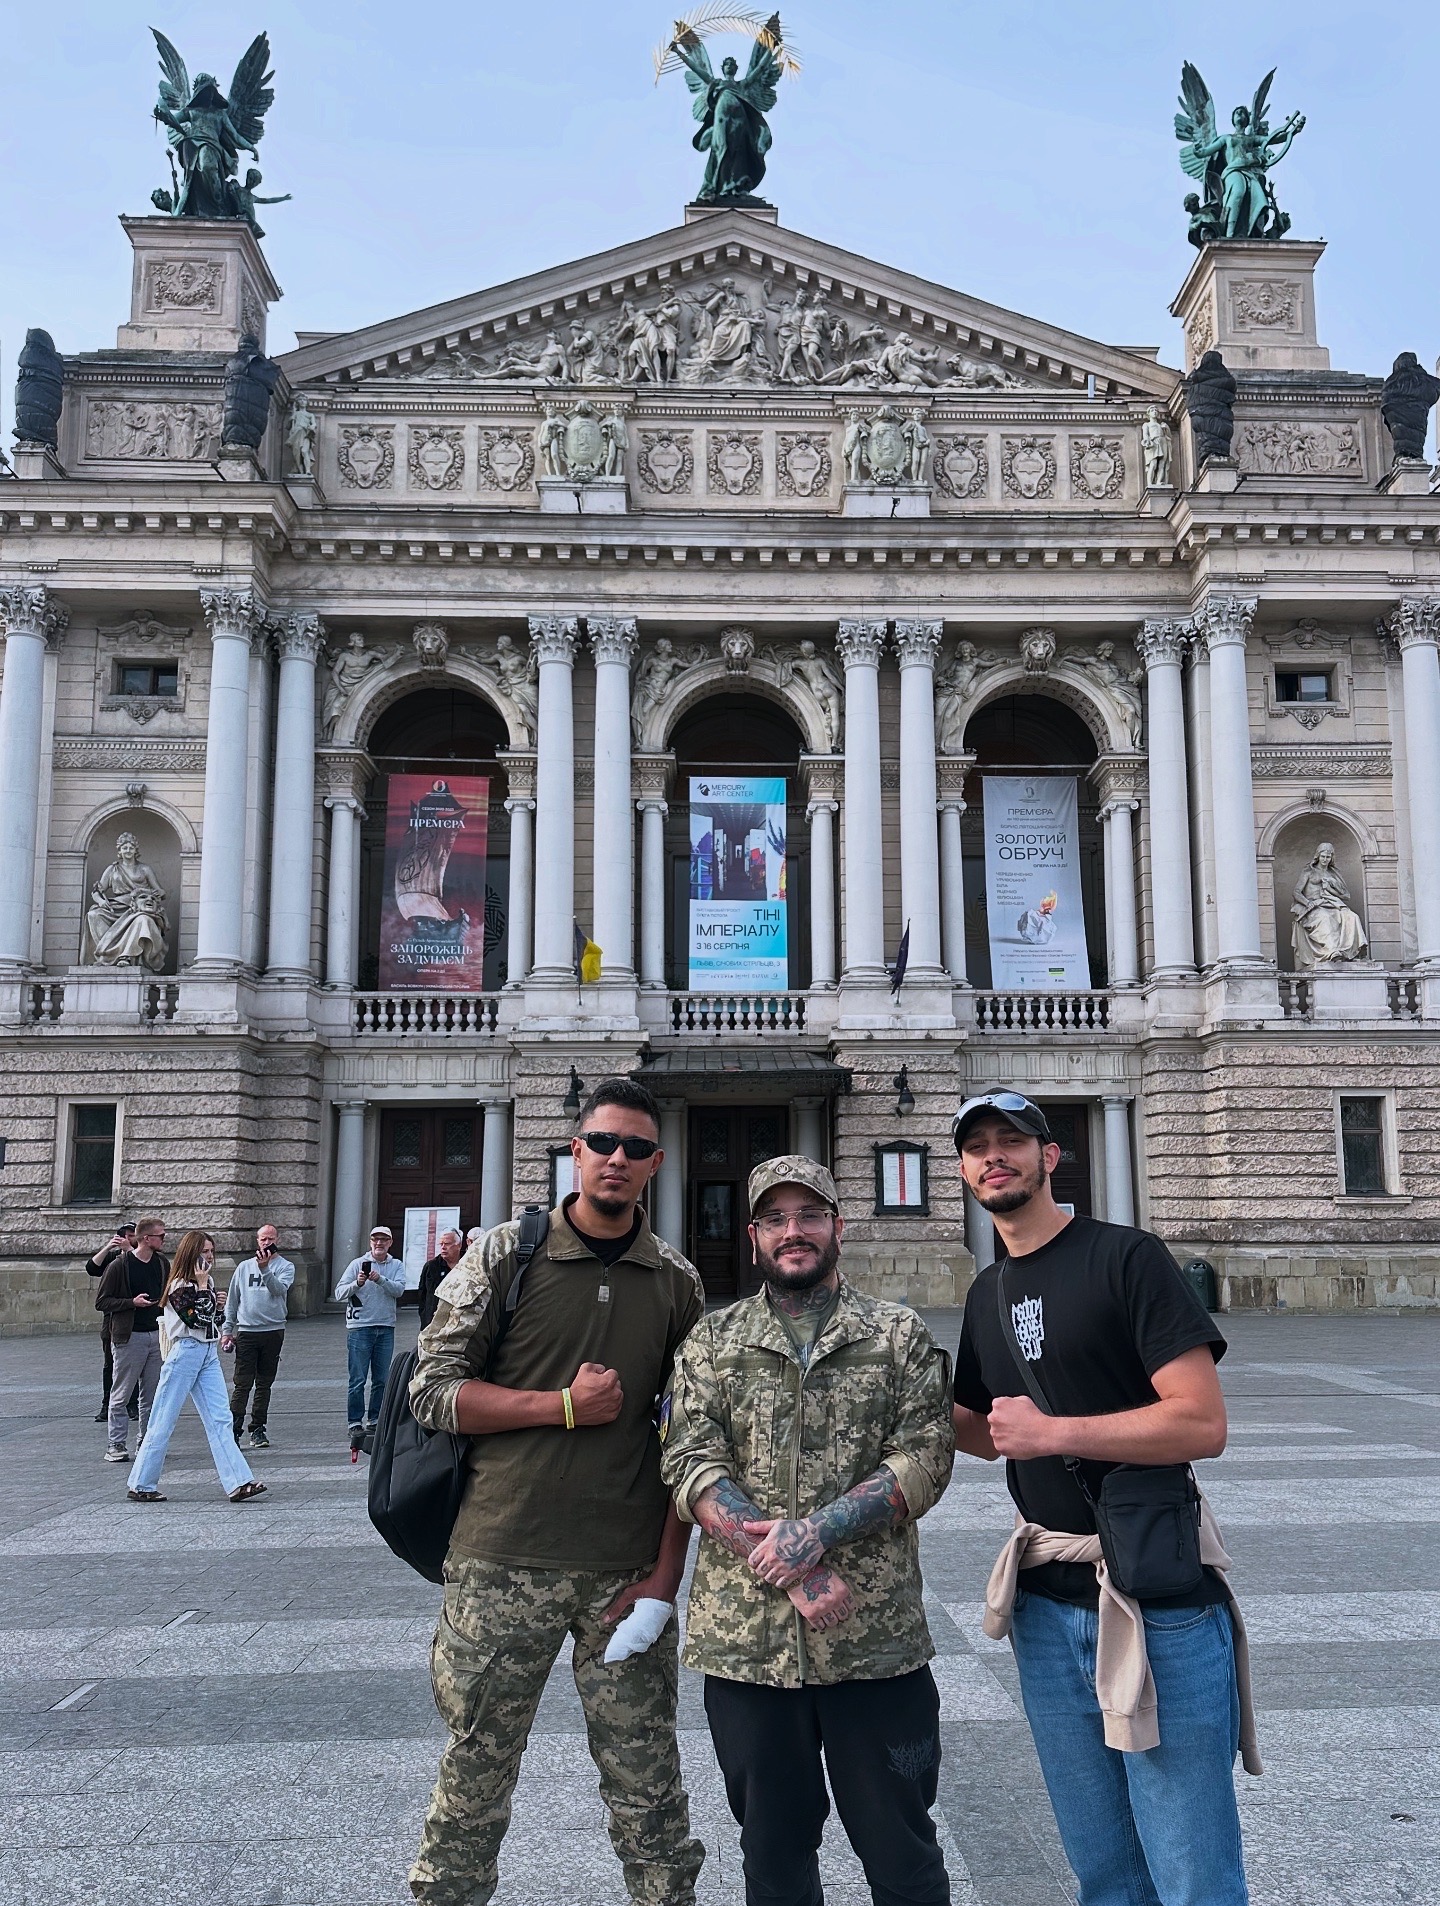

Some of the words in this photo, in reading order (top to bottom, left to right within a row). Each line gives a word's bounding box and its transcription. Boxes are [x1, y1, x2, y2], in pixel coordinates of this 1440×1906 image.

[409, 818, 466, 828] ПРЕМ'ЄРА
[995, 832, 1066, 844] ЗОЛОТИЙ
[998, 846, 1064, 860] ОБРУЧ
[753, 908, 780, 920] ТІНІ
[696, 924, 780, 936] ІМПЕРІАЛУ
[390, 944, 473, 955] ЗАПОРОЖЕЦЬ
[398, 954, 413, 964] ЗА
[414, 955, 465, 965] ДУНАЄМ
